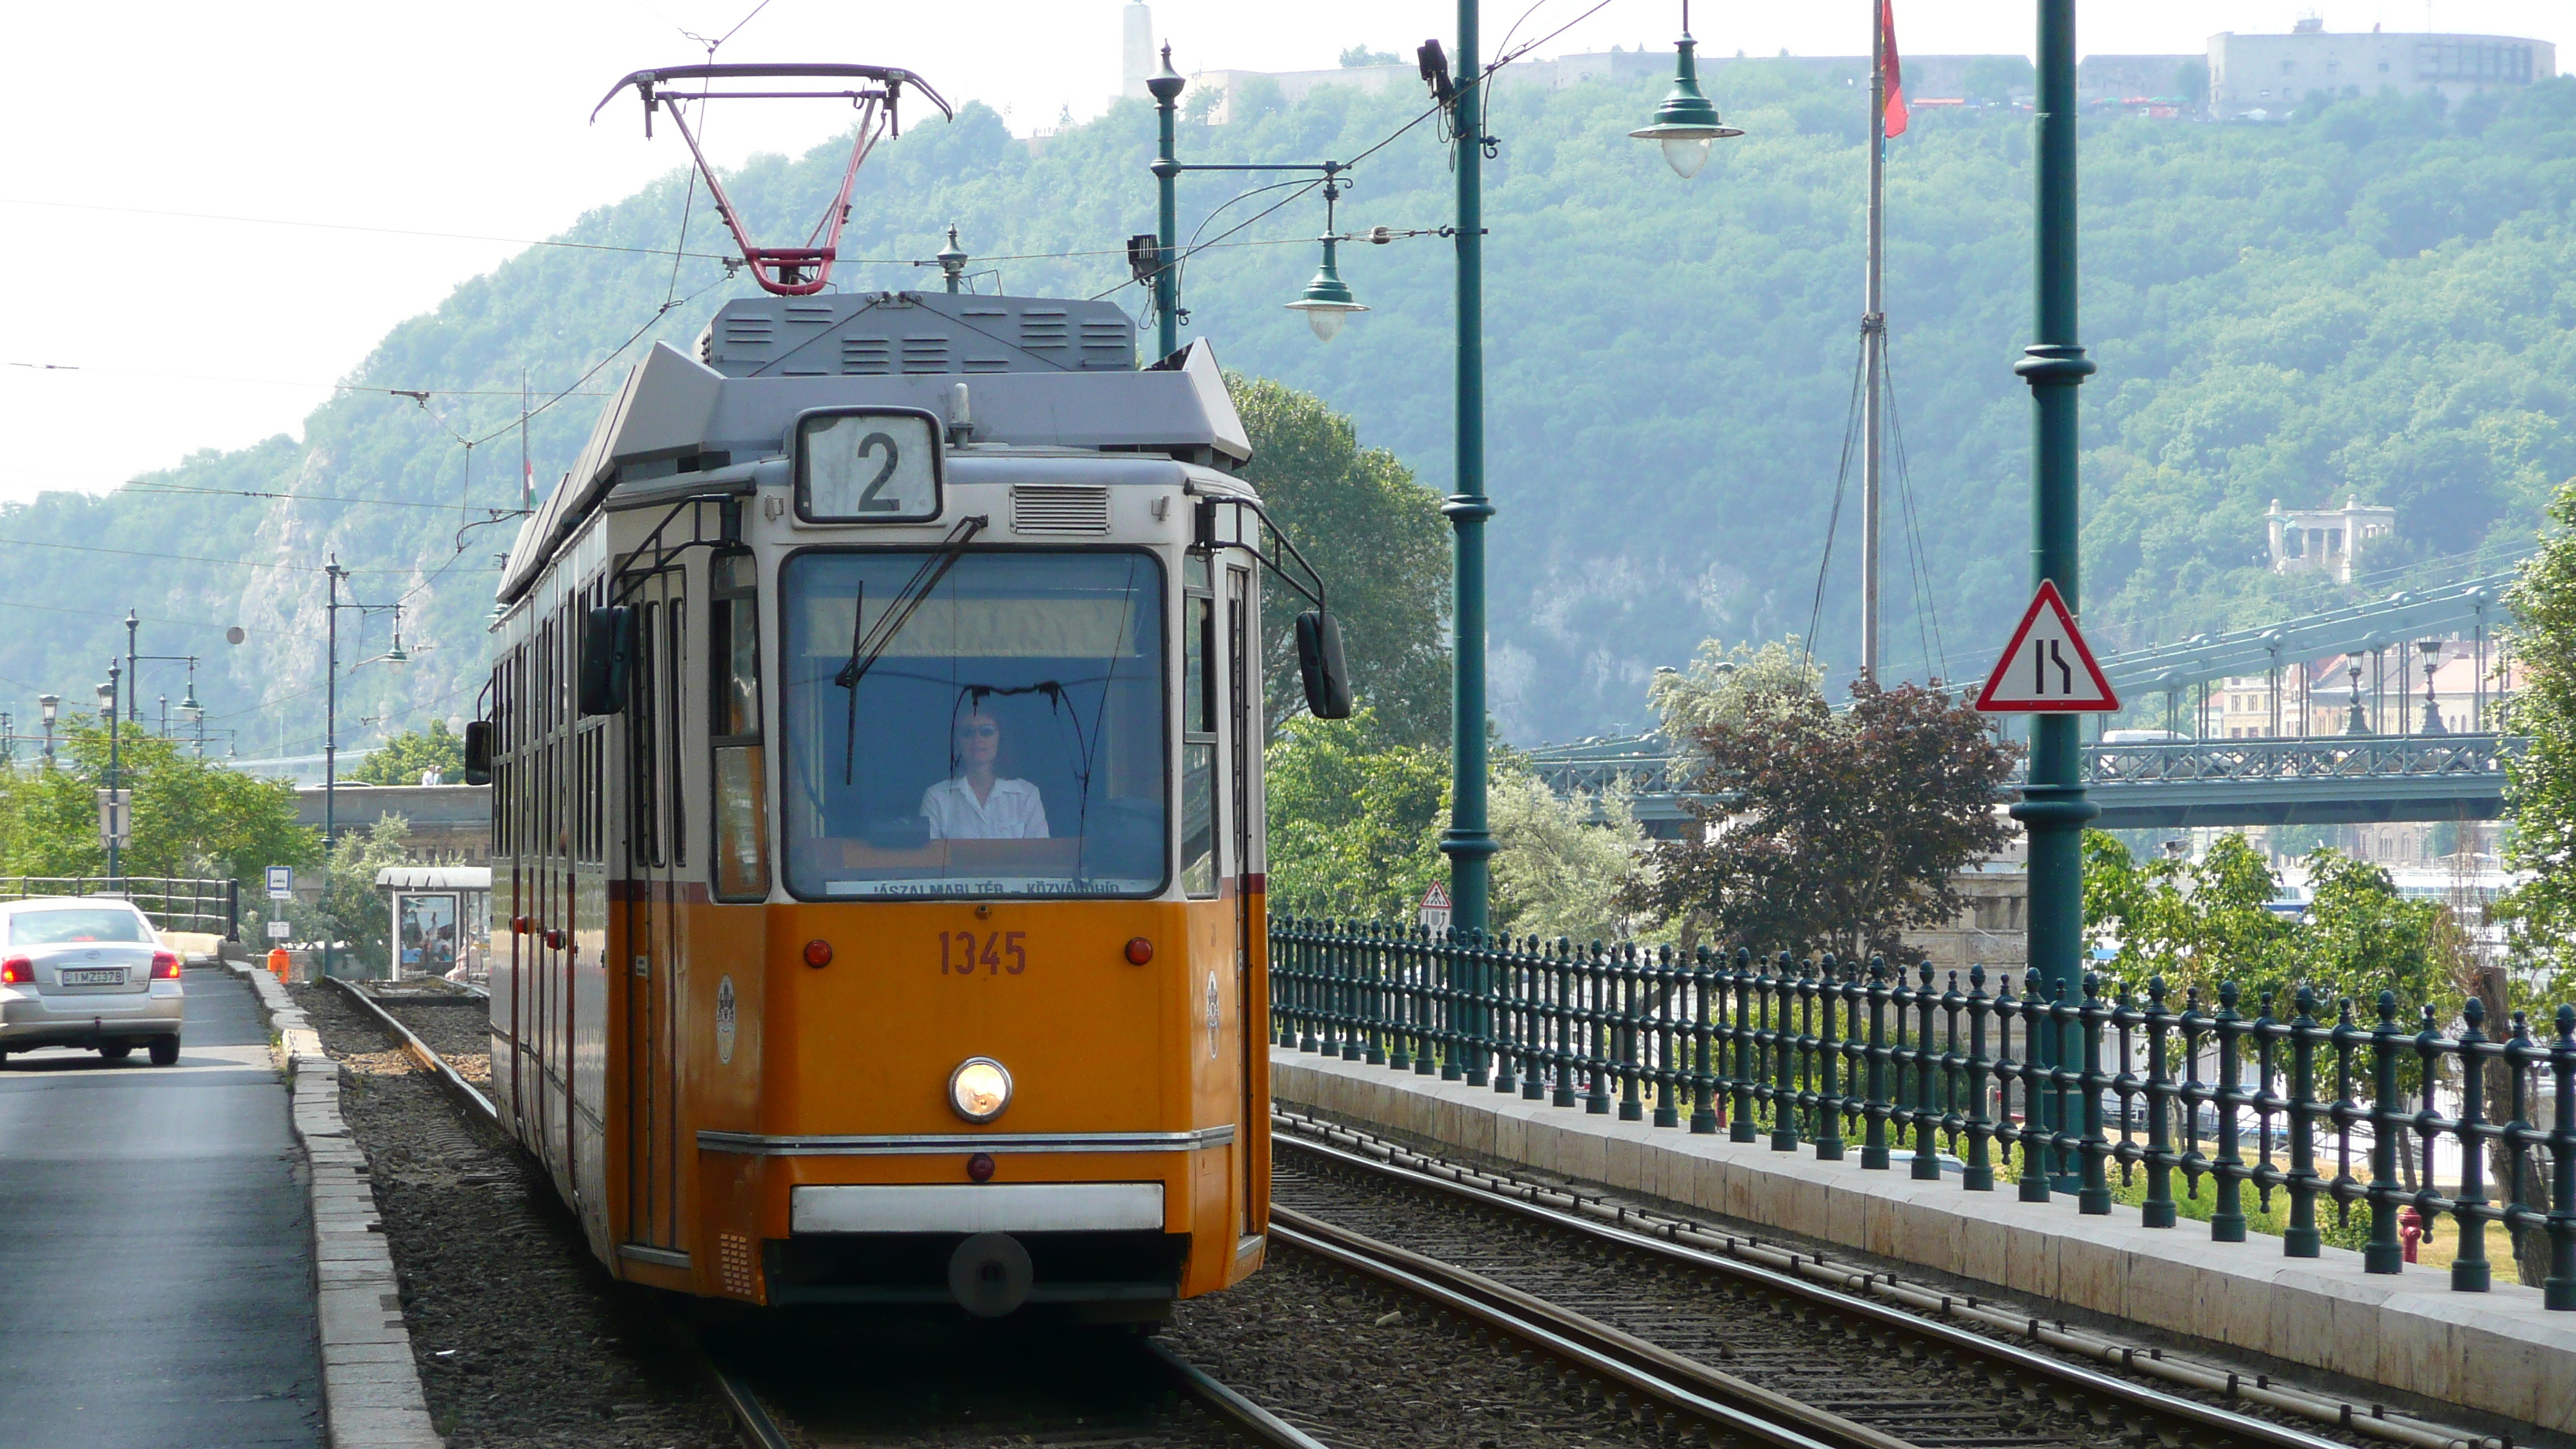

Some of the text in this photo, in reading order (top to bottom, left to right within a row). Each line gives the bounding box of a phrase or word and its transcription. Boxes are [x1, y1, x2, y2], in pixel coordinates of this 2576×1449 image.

[858, 432, 900, 512] 2
[1026, 881, 1120, 893] KÖZVÁHÍD
[939, 930, 1026, 975] 1345
